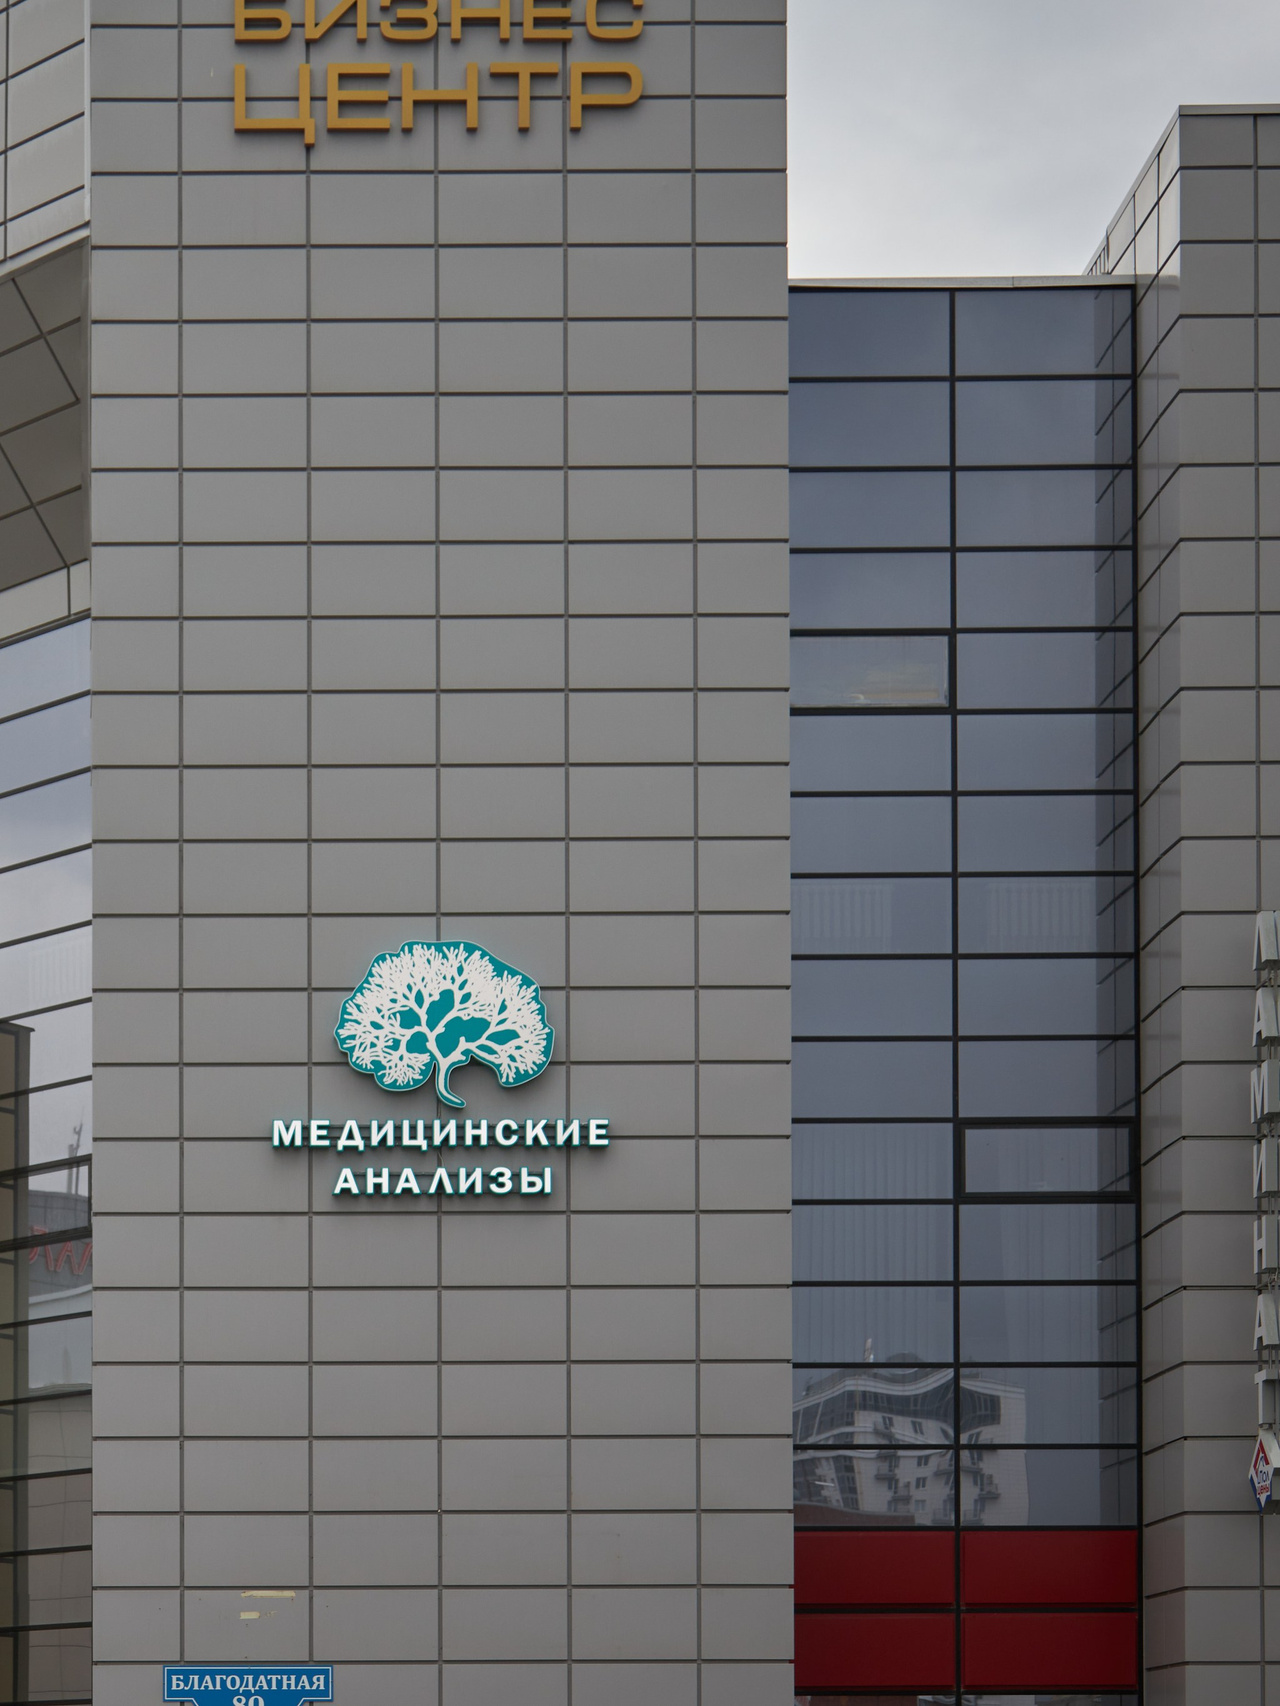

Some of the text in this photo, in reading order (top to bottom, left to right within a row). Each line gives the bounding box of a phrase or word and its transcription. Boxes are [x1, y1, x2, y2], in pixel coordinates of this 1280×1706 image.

[233, 0, 645, 43] БИЗНЕС
[233, 61, 644, 146] ЦЕНТР
[271, 1118, 610, 1152] МЕДИЦИНСКИЕ
[333, 1166, 553, 1196] АНАЛИЗЫ
[171, 1675, 326, 1693] БЛАГОДАТНАЯ
